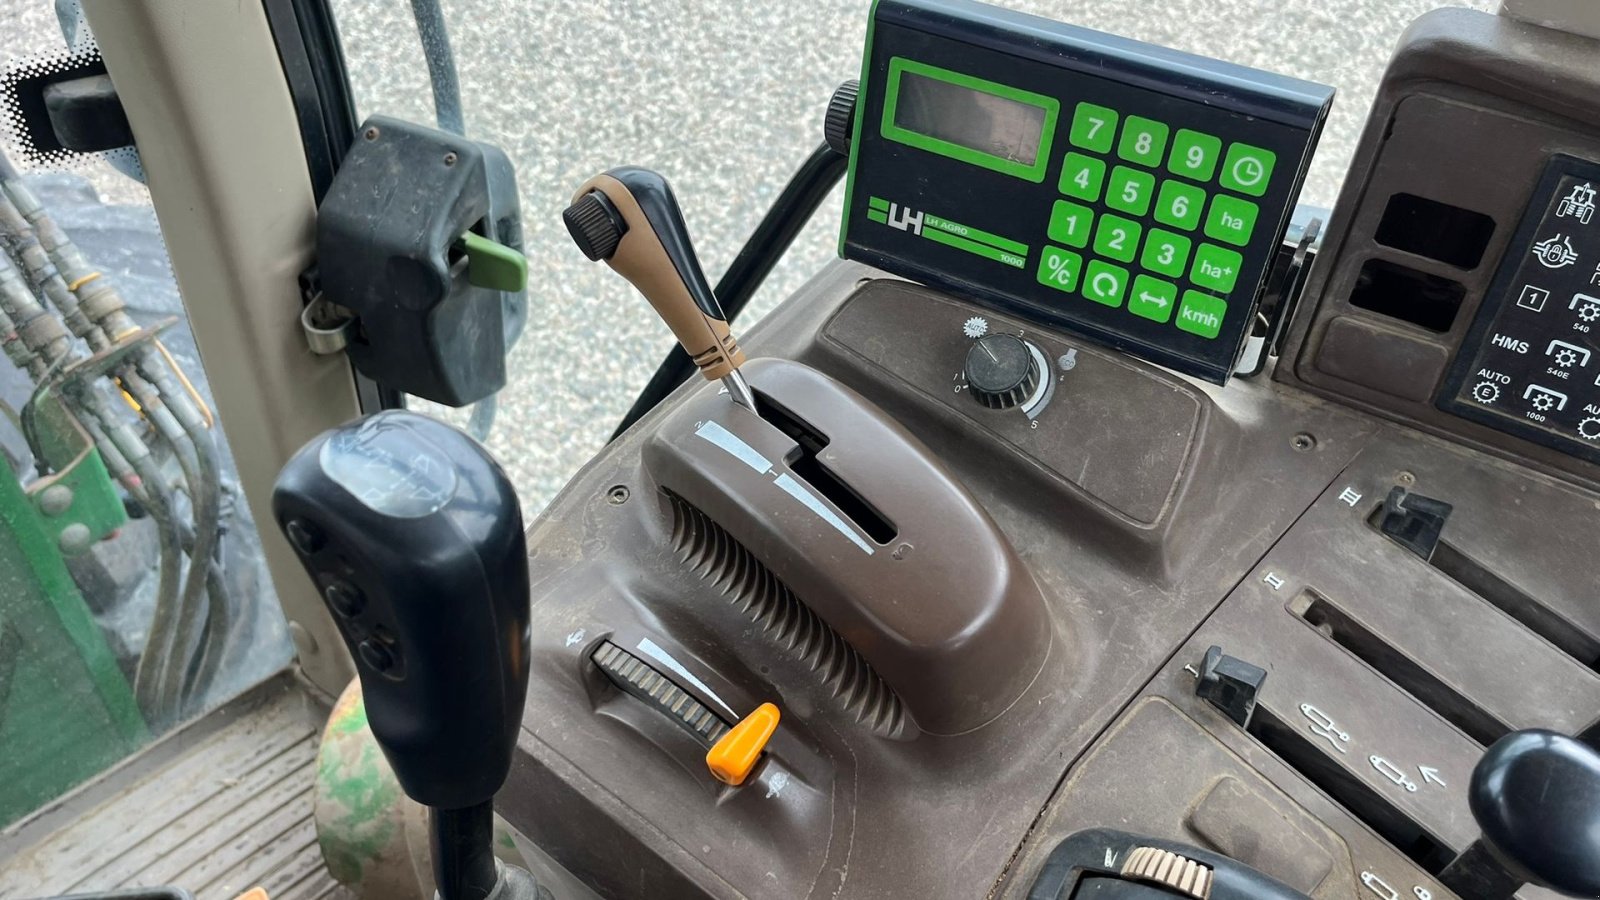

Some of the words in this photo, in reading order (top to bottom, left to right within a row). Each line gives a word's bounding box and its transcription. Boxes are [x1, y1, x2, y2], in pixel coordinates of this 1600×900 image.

[1087, 117, 1104, 140] 7
[1134, 132, 1152, 155] 8
[1185, 145, 1204, 169] 9
[1074, 168, 1090, 190] 4
[1122, 181, 1140, 203] 5
[1171, 196, 1189, 218] 6
[887, 202, 924, 236] LH
[926, 217, 938, 227] LH
[940, 221, 968, 236] AGRO
[1066, 215, 1077, 235] 1
[1220, 211, 1243, 231] ha
[1108, 228, 1126, 250] 2
[1000, 253, 1023, 268] 1000
[1157, 244, 1175, 265] 3
[1529, 293, 1538, 305] 1
[1182, 305, 1219, 328] kmh
[1572, 322, 1590, 333] 540
[1491, 333, 1530, 354] HMS
[1477, 368, 1511, 385] AUTO
[1546, 367, 1570, 380] 540E
[1481, 387, 1492, 397] E
[1526, 411, 1546, 423] 1000
